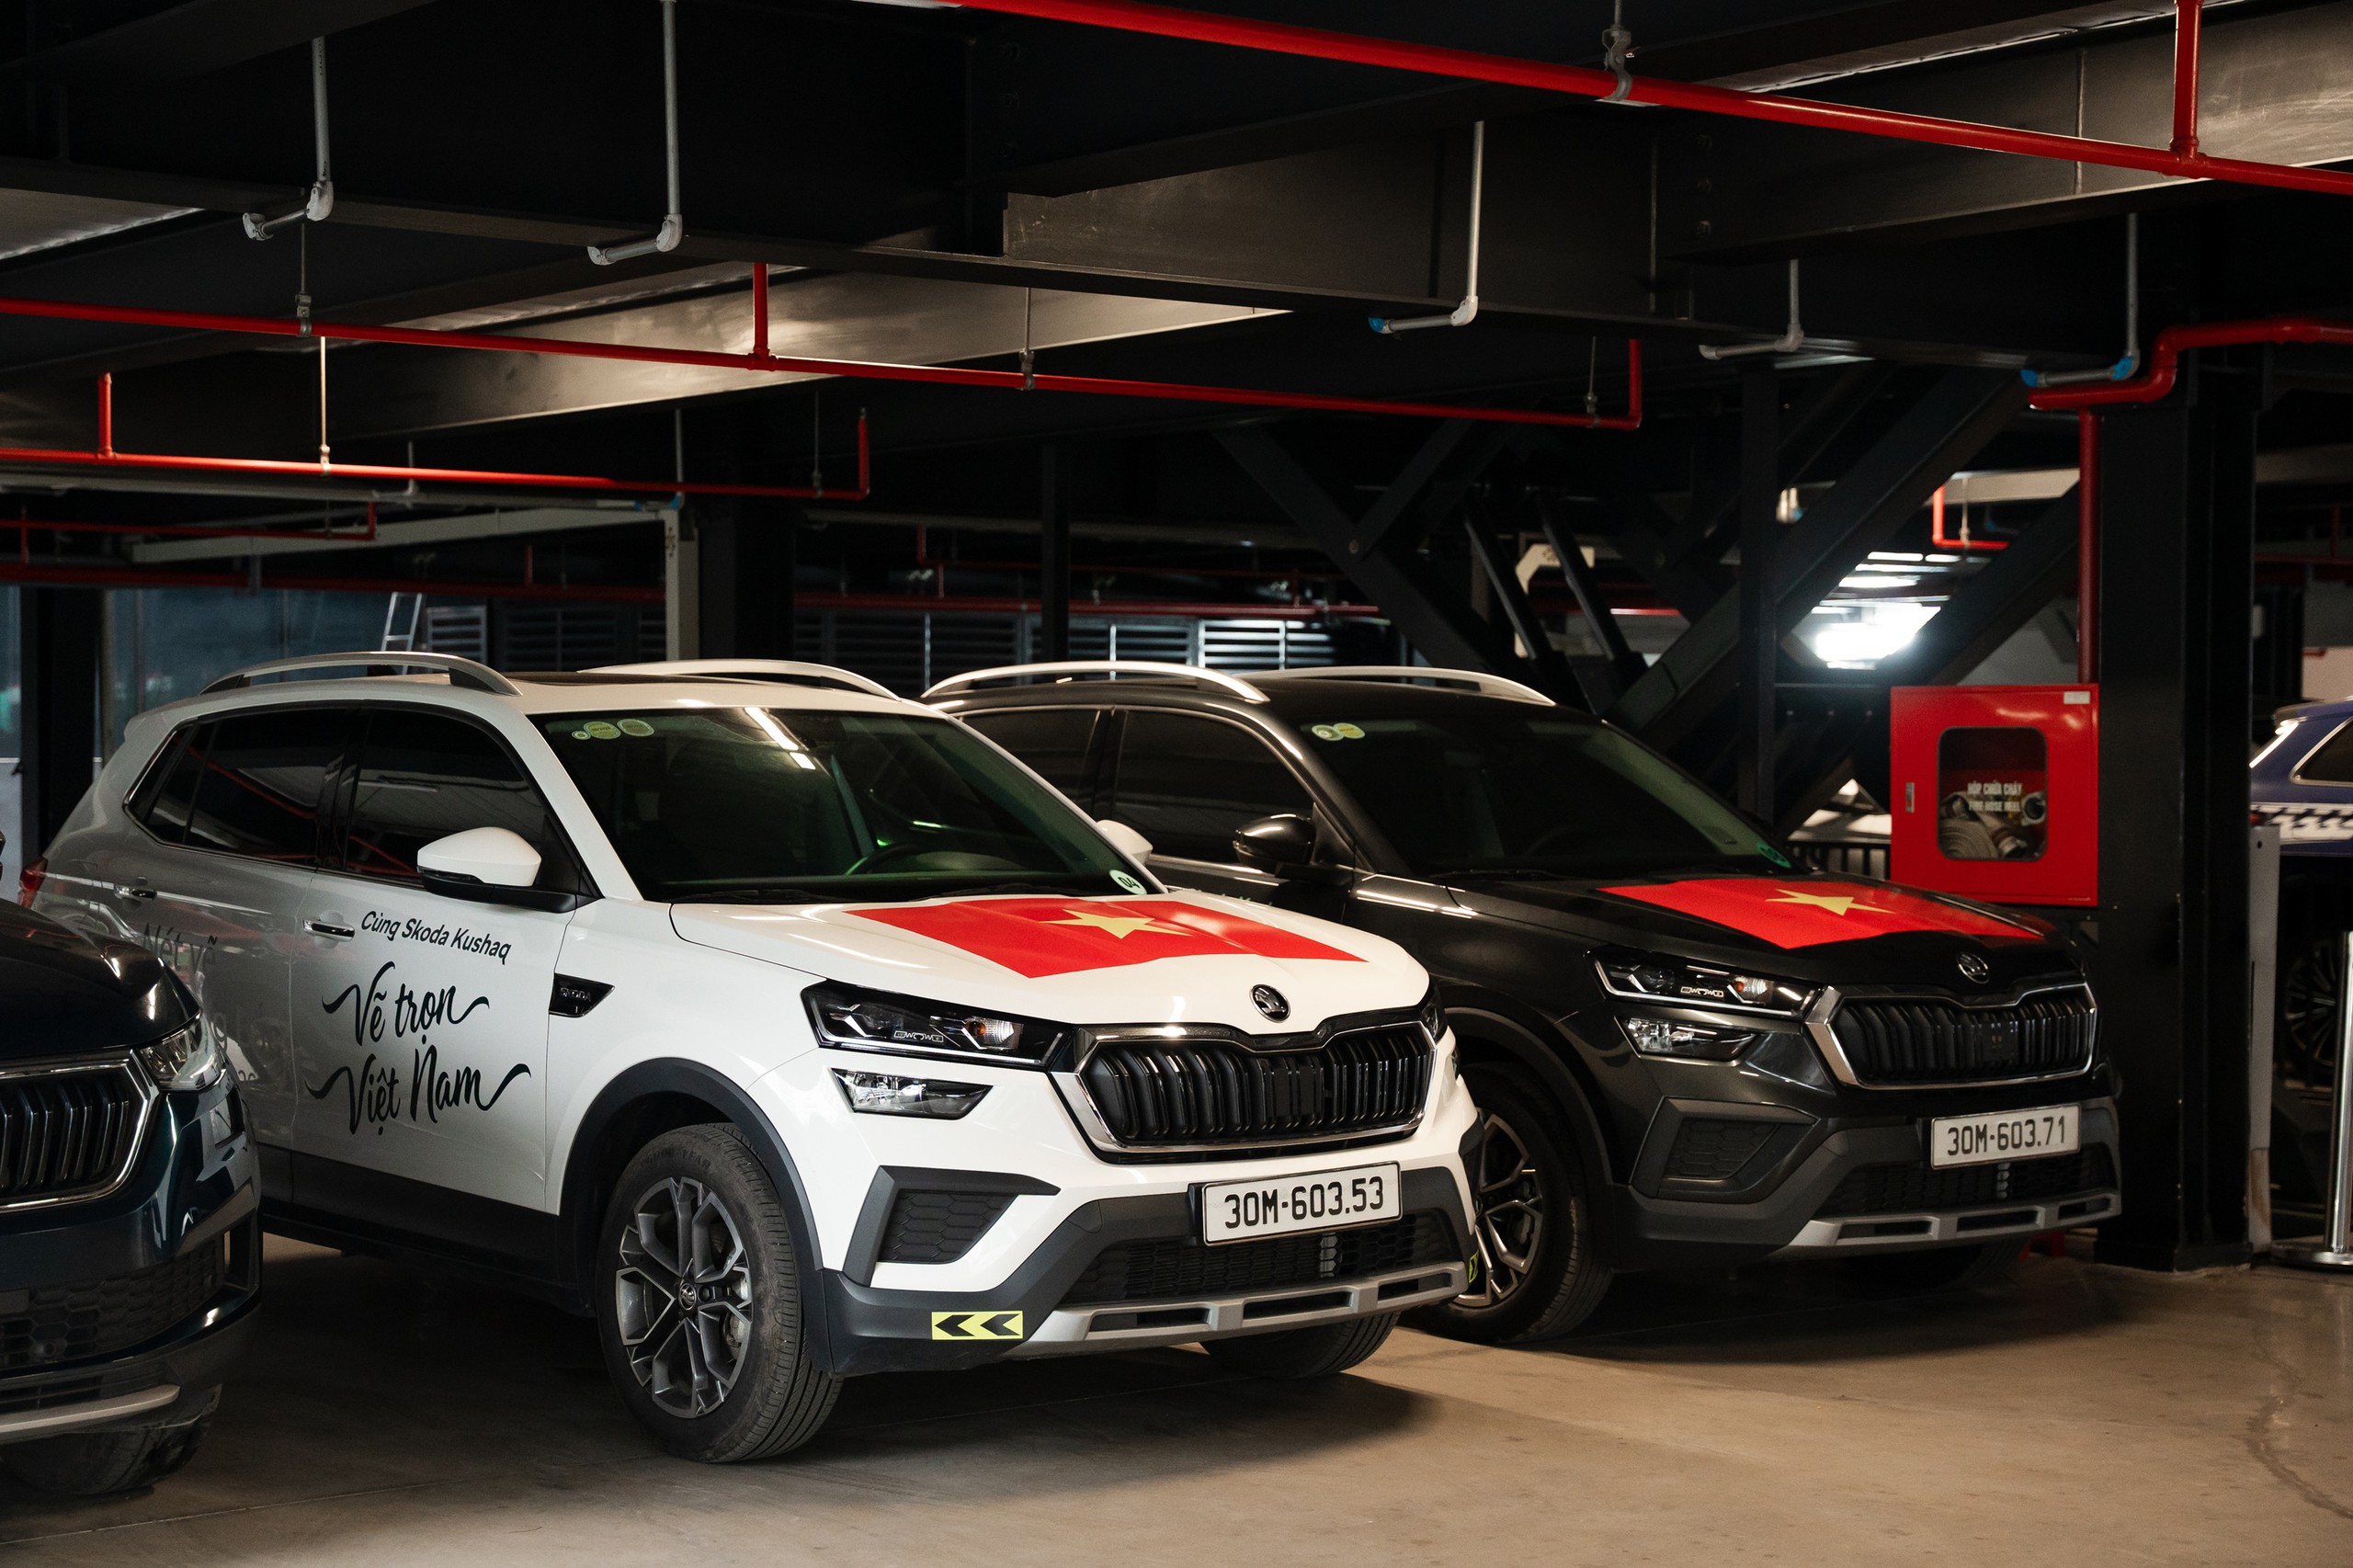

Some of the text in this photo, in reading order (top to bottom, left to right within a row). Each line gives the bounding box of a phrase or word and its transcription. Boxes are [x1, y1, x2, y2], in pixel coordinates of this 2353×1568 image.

[402, 918, 450, 947] Skoda
[450, 927, 512, 965] Kushaq
[322, 961, 490, 1046] Vẽ trọn
[304, 1044, 532, 1136] Việt Nam
